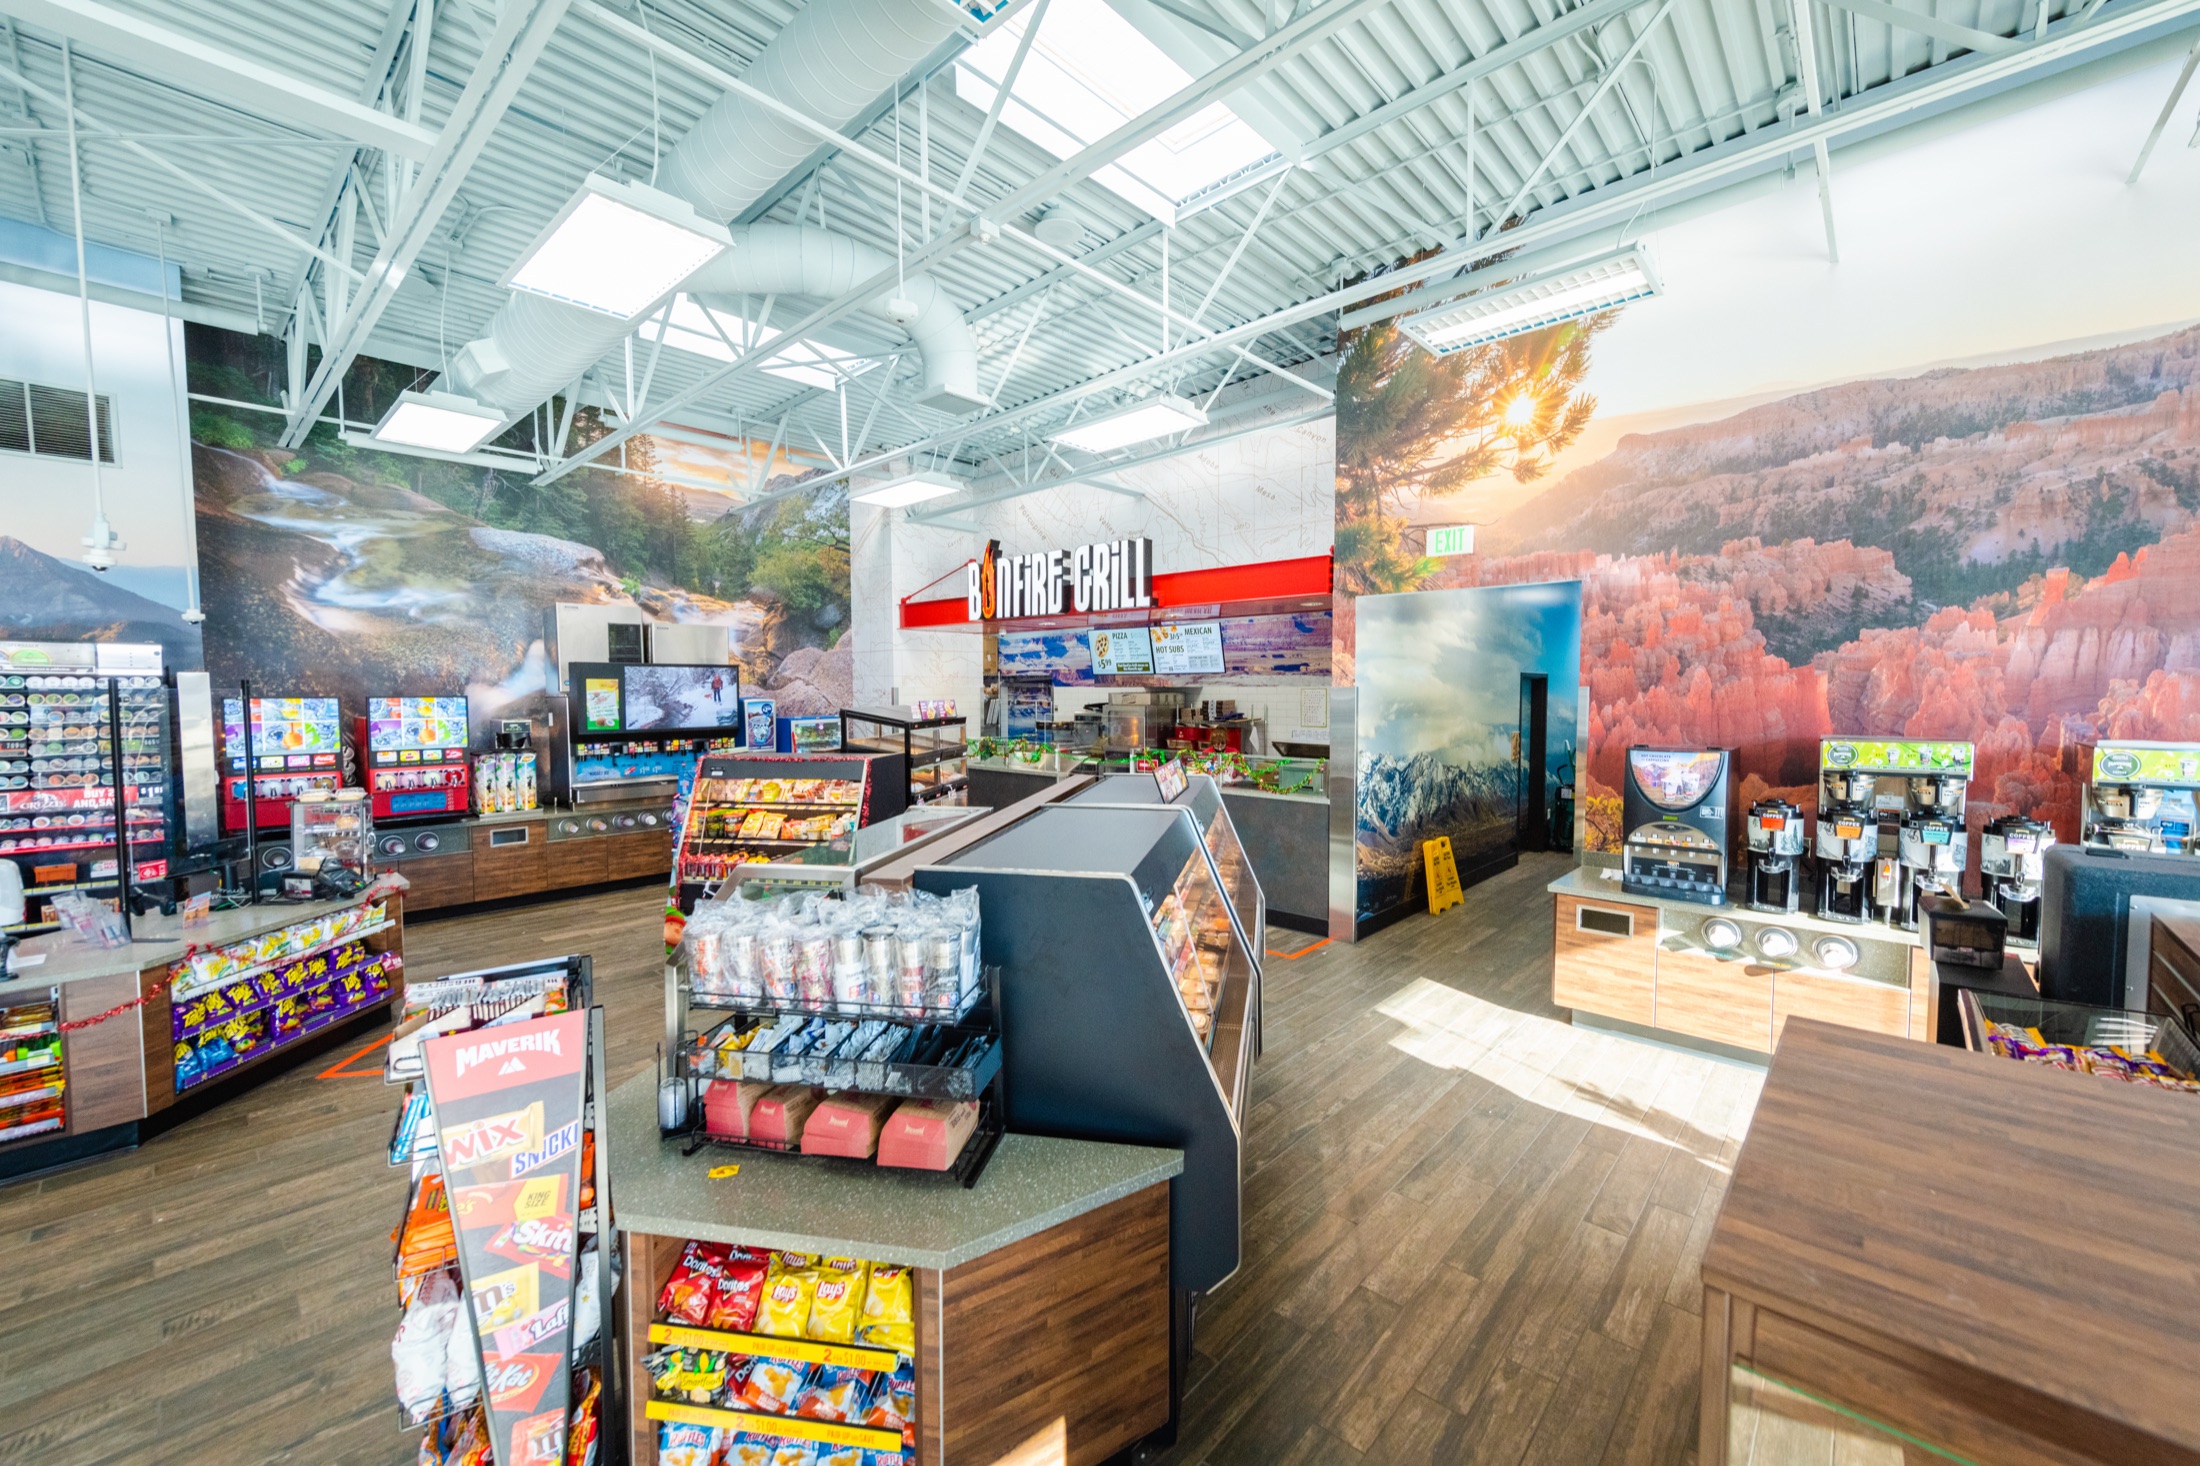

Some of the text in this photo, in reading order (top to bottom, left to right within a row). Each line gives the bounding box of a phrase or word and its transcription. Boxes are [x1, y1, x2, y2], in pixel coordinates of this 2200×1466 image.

[1255, 484, 1276, 501] Mesa
[1018, 503, 1048, 542] Porcupine
[1434, 528, 1465, 553] EXIT
[1074, 538, 1150, 612] GRILL
[1112, 632, 1128, 640] PIZZA
[1184, 626, 1212, 636] MEXICAN
[1155, 645, 1185, 654] HOT SUBS
[83, 788, 105, 799] BUY
[2115, 843, 2147, 851] COFFEE
[456, 1028, 564, 1079] MAVERIK
[528, 1190, 552, 1200] KING
[524, 1199, 547, 1209] SIZE
[682, 1254, 719, 1279] Doritos
[717, 1277, 751, 1293] Doritos
[663, 1328, 673, 1341] 2
[683, 1331, 704, 1346] $1.00
[753, 1341, 767, 1351] PAIR
[767, 1343, 775, 1352] UP
[784, 1344, 799, 1356] SAVE
[823, 1348, 832, 1362] 2
[844, 1351, 866, 1366] $1.00
[680, 1373, 722, 1387] Smartfood
[736, 1415, 744, 1428] 2
[755, 1418, 777, 1433] $1.00
[668, 1429, 705, 1447] RUFFLES
[826, 1429, 840, 1439] PAIR
[841, 1430, 850, 1440] UP
[859, 1432, 876, 1445] SAVE
